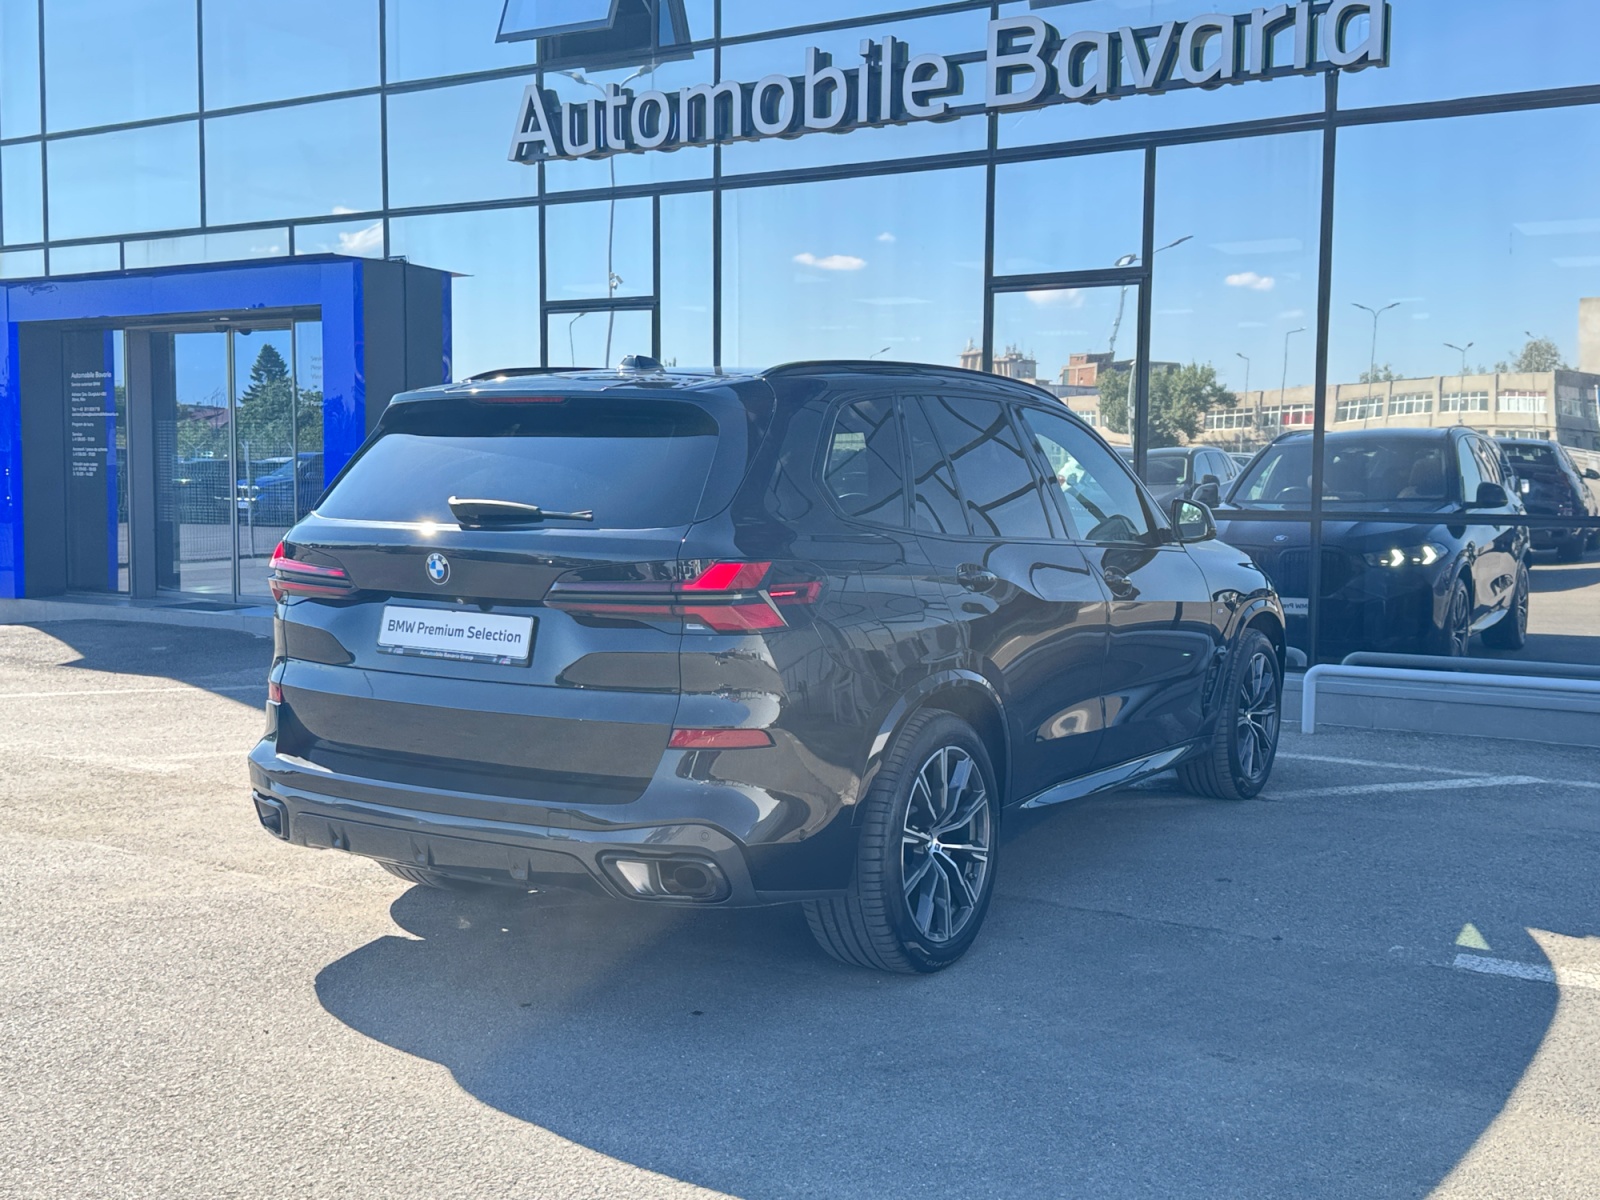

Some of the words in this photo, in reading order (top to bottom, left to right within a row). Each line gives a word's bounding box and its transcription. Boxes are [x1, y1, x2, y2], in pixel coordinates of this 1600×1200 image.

[507, 35, 960, 163] Automobile
[985, 0, 1390, 108] Bavaria
[71, 371, 94, 379] Automobile
[387, 619, 416, 633] BMW
[417, 622, 464, 638] Premium
[467, 626, 521, 644] Selection
